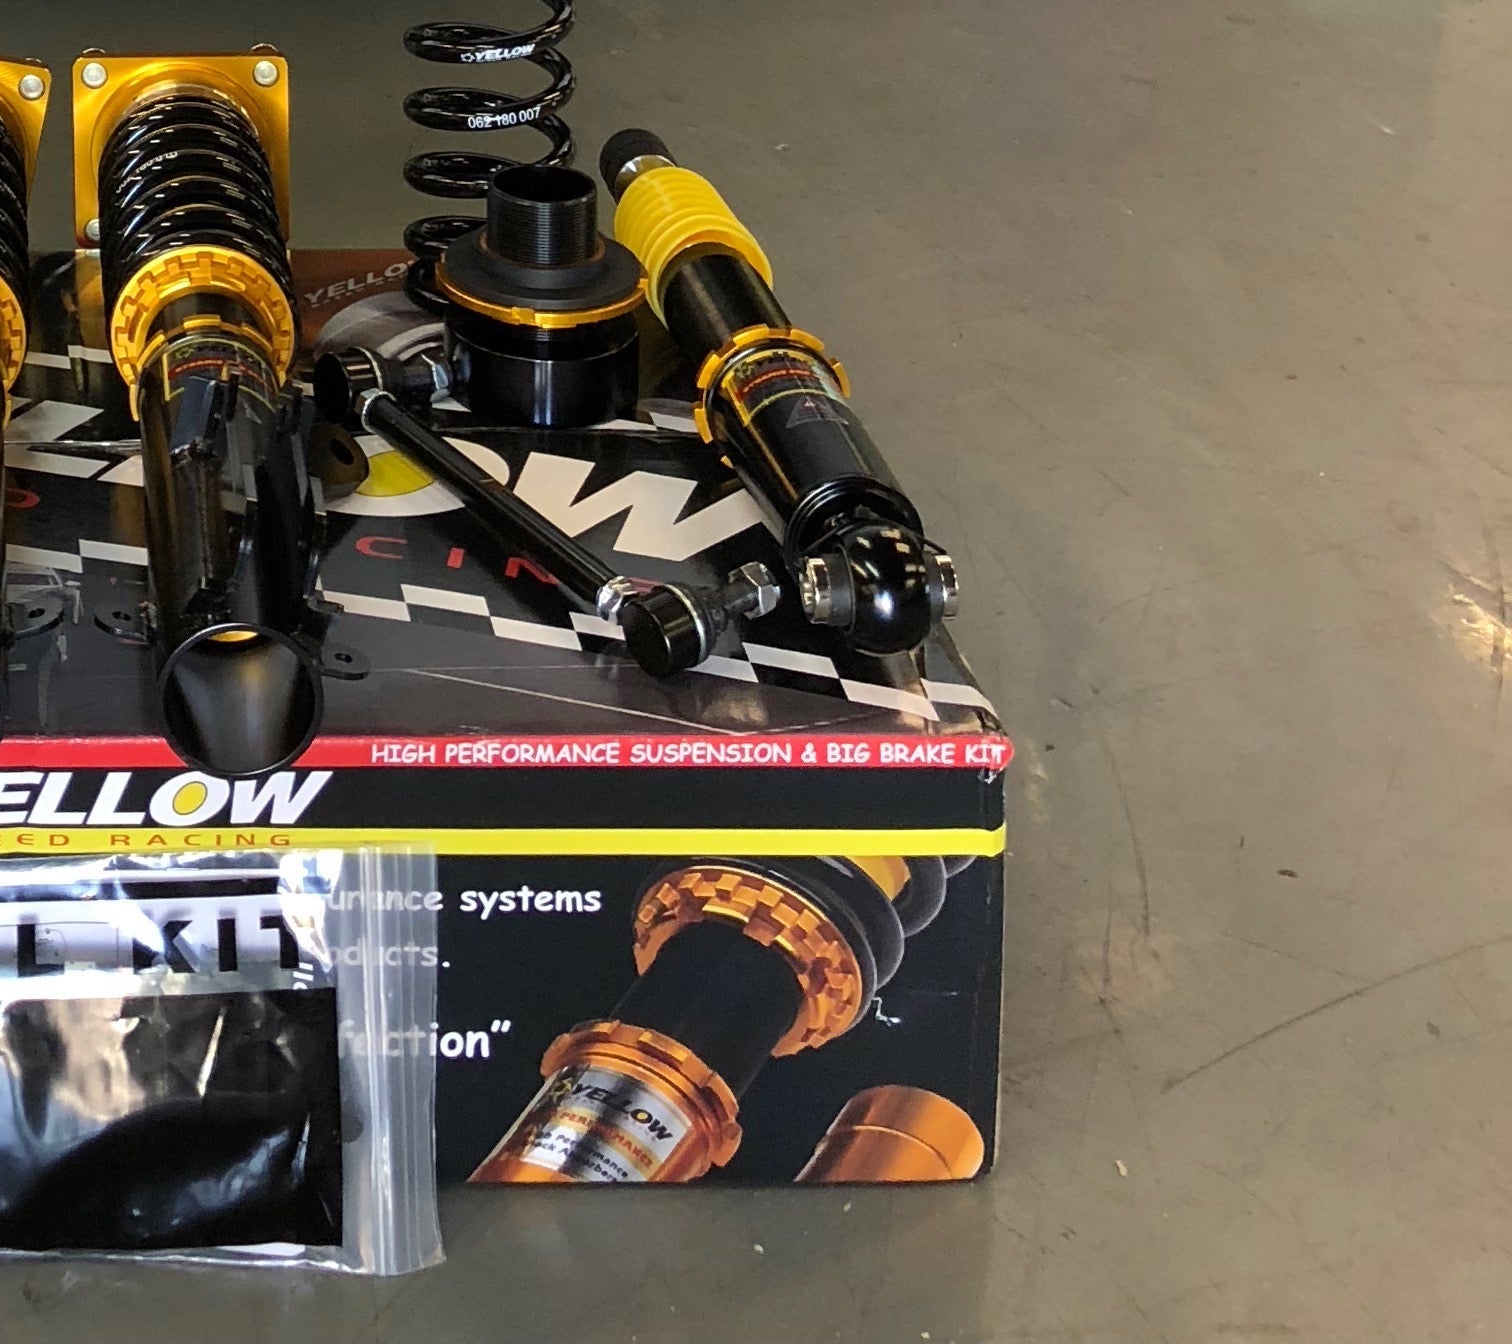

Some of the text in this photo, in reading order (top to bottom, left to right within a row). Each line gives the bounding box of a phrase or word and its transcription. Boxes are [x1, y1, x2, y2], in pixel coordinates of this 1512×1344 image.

[475, 43, 535, 60] YELLOW
[468, 105, 541, 128] 062 180 007
[304, 259, 414, 304] YELLO
[371, 742, 1005, 764] HIGH PERFORMANCE SUSPENSION & BIG BRAKE KIT
[110, 833, 292, 847] RACING
[459, 885, 602, 921] systems
